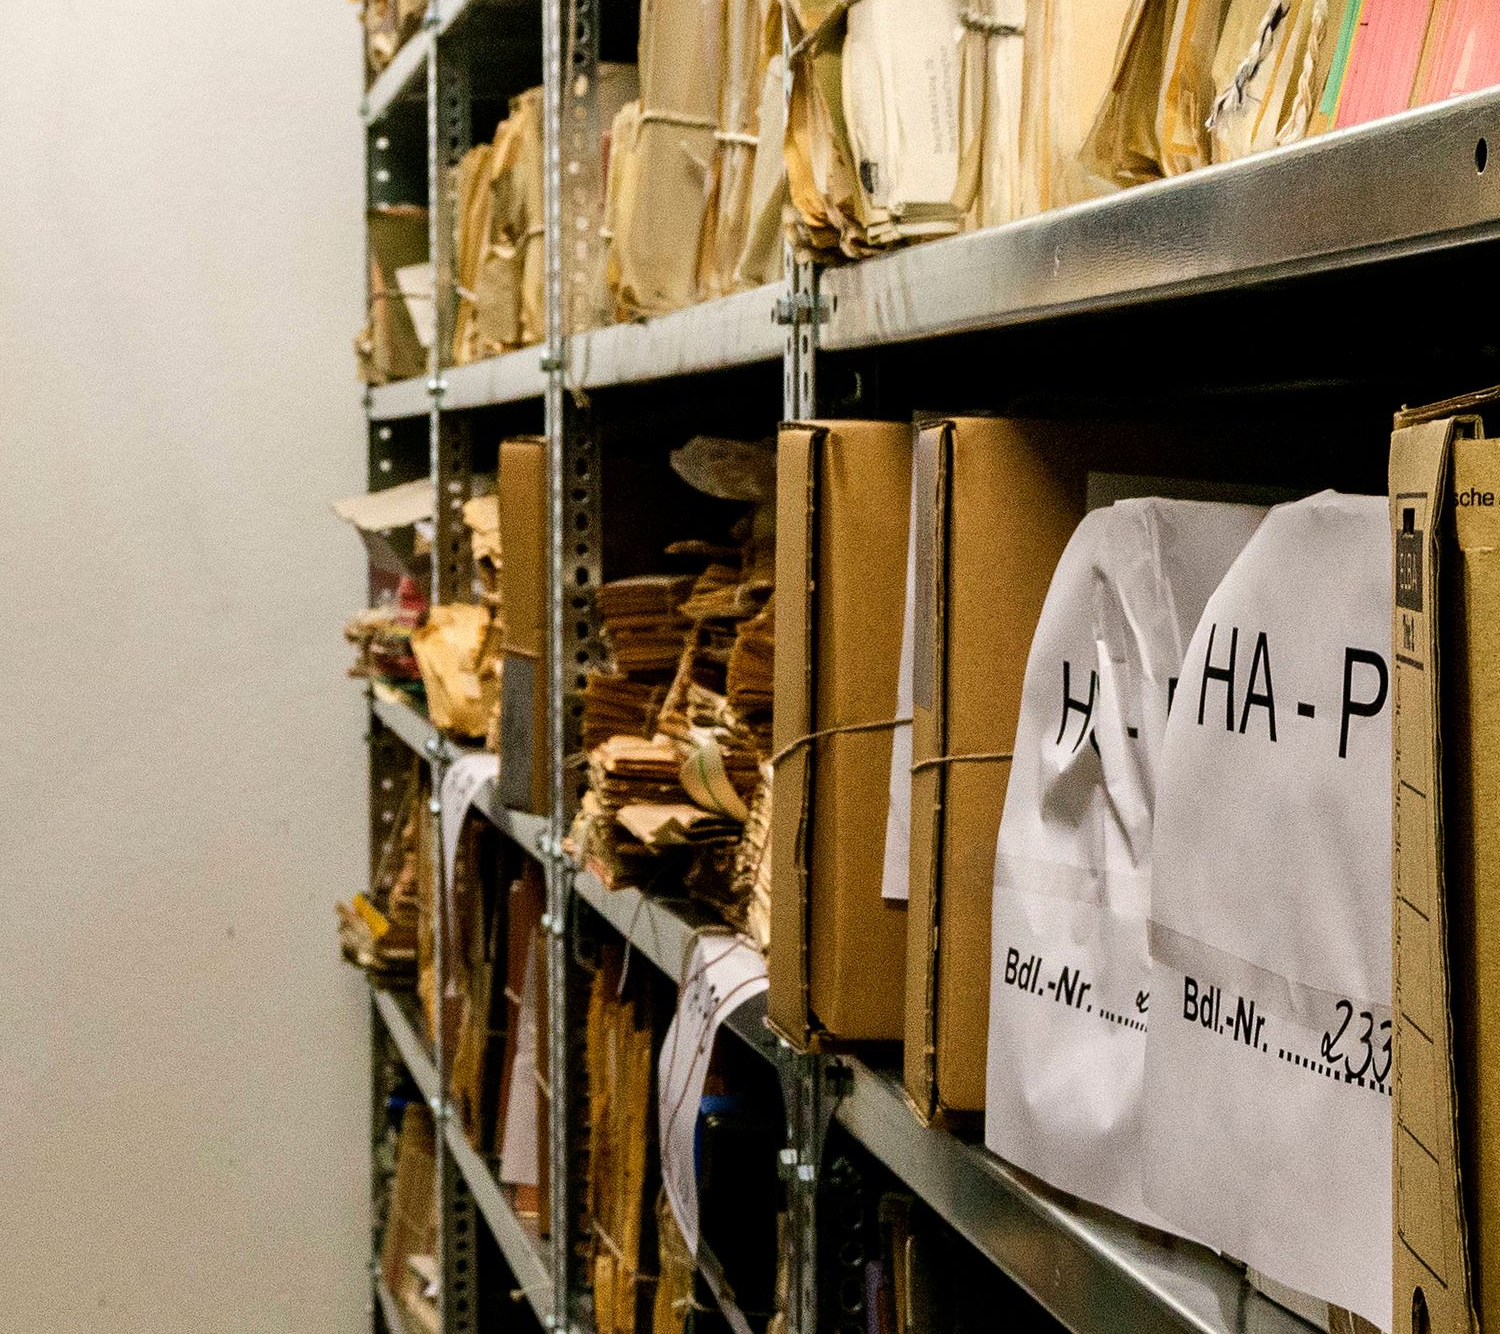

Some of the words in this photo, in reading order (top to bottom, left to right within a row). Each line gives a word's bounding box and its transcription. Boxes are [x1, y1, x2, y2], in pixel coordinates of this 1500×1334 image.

[1338, 646, 1390, 759] P
[1003, 946, 1093, 1013] Bdl.-Nr.
[1182, 974, 1269, 1053] Bdl.-Nr.
[1320, 998, 1392, 1085] 233
